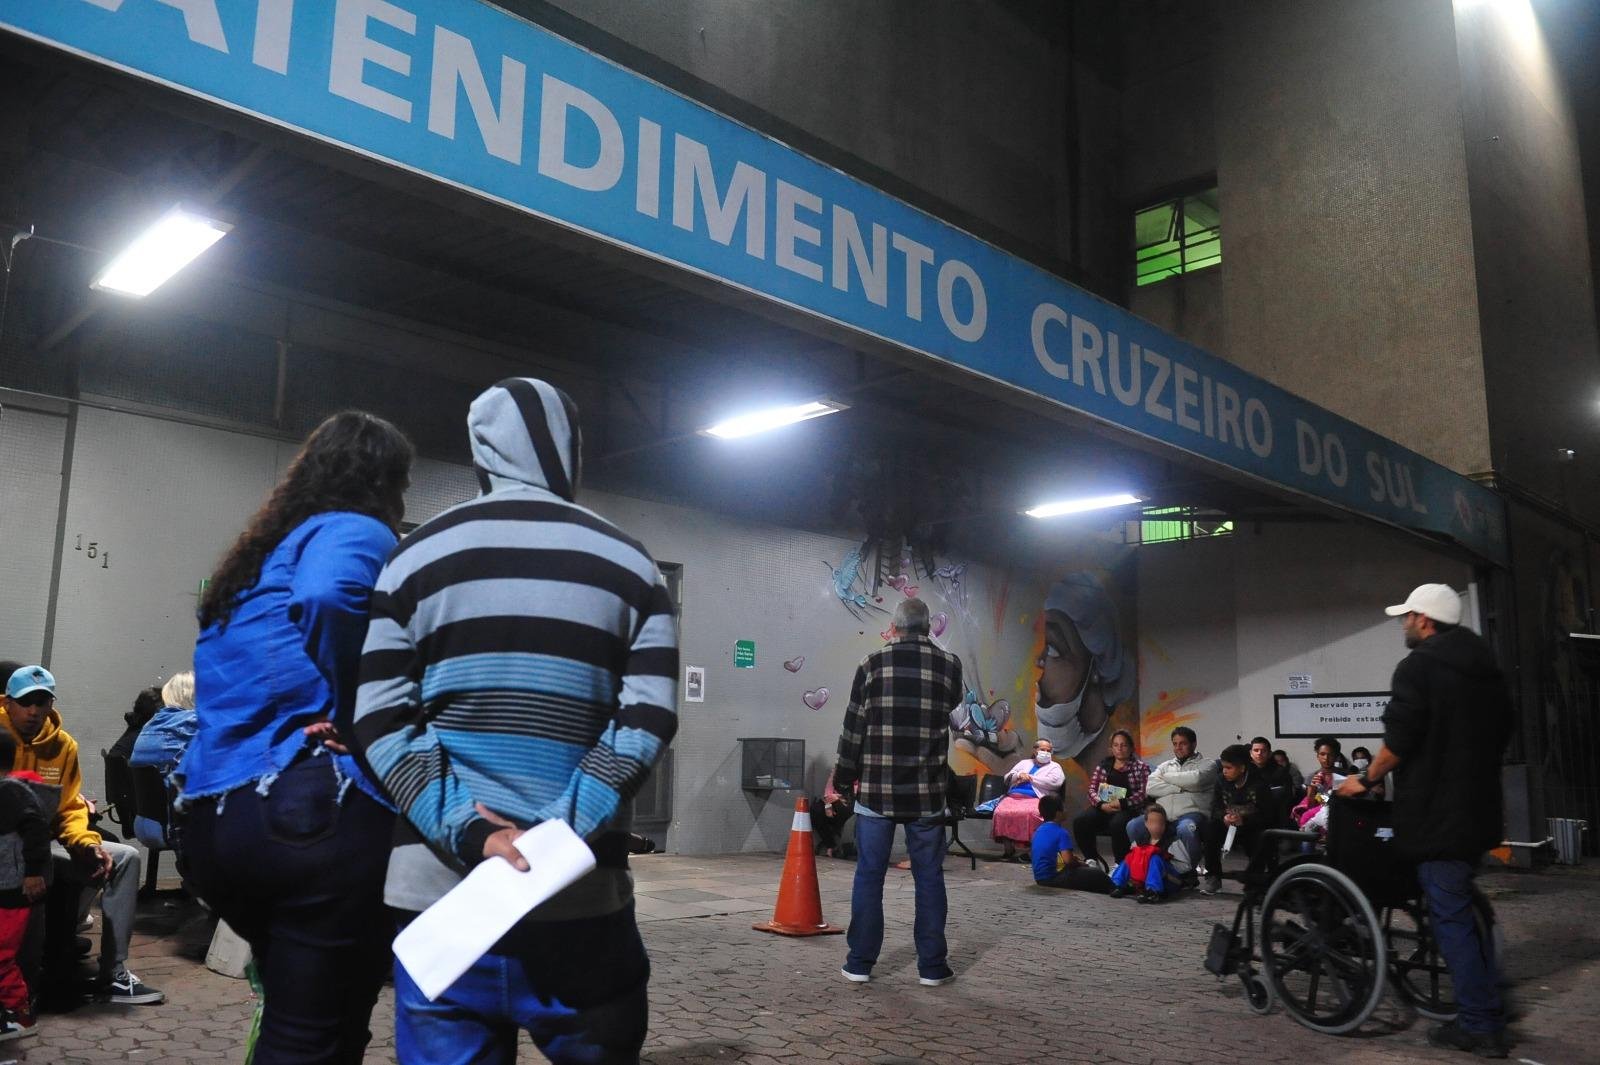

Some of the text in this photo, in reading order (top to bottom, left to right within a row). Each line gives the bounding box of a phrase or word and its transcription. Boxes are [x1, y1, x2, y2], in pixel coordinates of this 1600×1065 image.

[86, 0, 1429, 515] ENDIMENTO CRUZEIRO DO SUL
[1353, 702, 1371, 710] para
